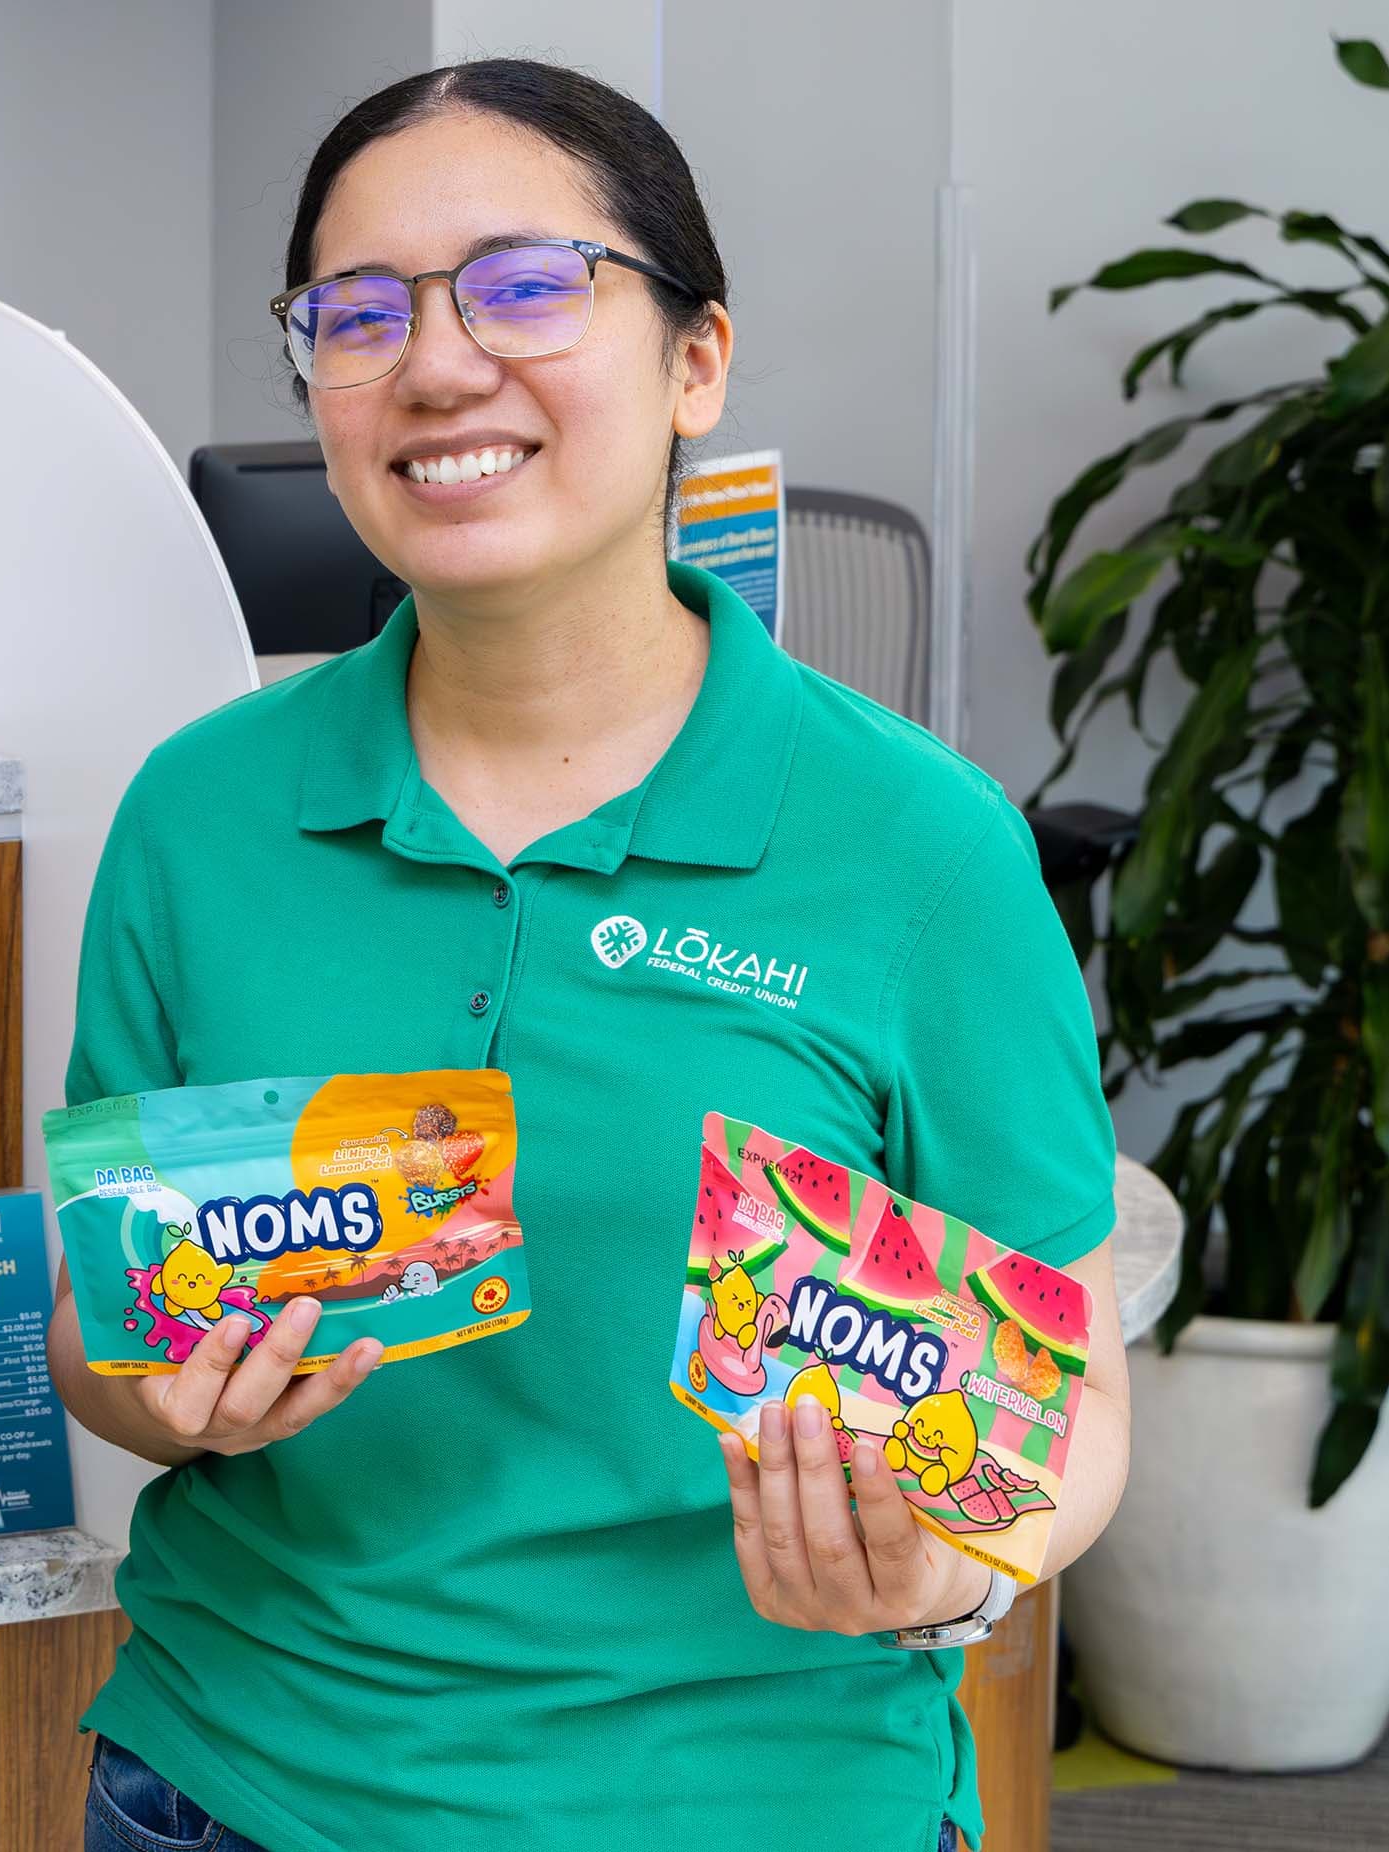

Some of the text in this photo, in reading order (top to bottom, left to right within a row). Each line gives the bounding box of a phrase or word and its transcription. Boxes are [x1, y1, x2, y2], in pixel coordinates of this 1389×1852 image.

[652, 927, 808, 995] LŌKAHI
[647, 956, 798, 1010] FEDERAL CREDIT UNION
[341, 1136, 379, 1147] Covered
[334, 1146, 389, 1161] Li Hing &
[321, 1158, 392, 1175] Lemon Peel
[96, 1166, 154, 1186] DA BAG
[99, 1183, 162, 1197] RESEALABLE BAG
[411, 1181, 477, 1212] BURSTS
[739, 1194, 755, 1216] DA
[758, 1203, 784, 1230] BAG
[205, 1191, 374, 1259] NOMS
[932, 1297, 980, 1327] Li Hing &
[26, 1322, 43, 1331] each
[915, 1303, 979, 1340] Lemon Peel
[789, 1285, 940, 1397] NOMS
[3, 1357, 20, 1365] First
[31, 1354, 46, 1362] free
[110, 1361, 149, 1369] GUMMY SNACK
[25, 1406, 52, 1416] $25.00
[968, 1373, 1066, 1435] WATERMELON
[0, 1431, 26, 1441] CO-OP
[27, 1431, 35, 1439] or
[8, 1439, 53, 1451] withdrawals
[2, 1453, 14, 1463] per
[964, 1543, 973, 1553] NET
[975, 1548, 983, 1558] WT
[993, 1558, 1001, 1567] OZ
